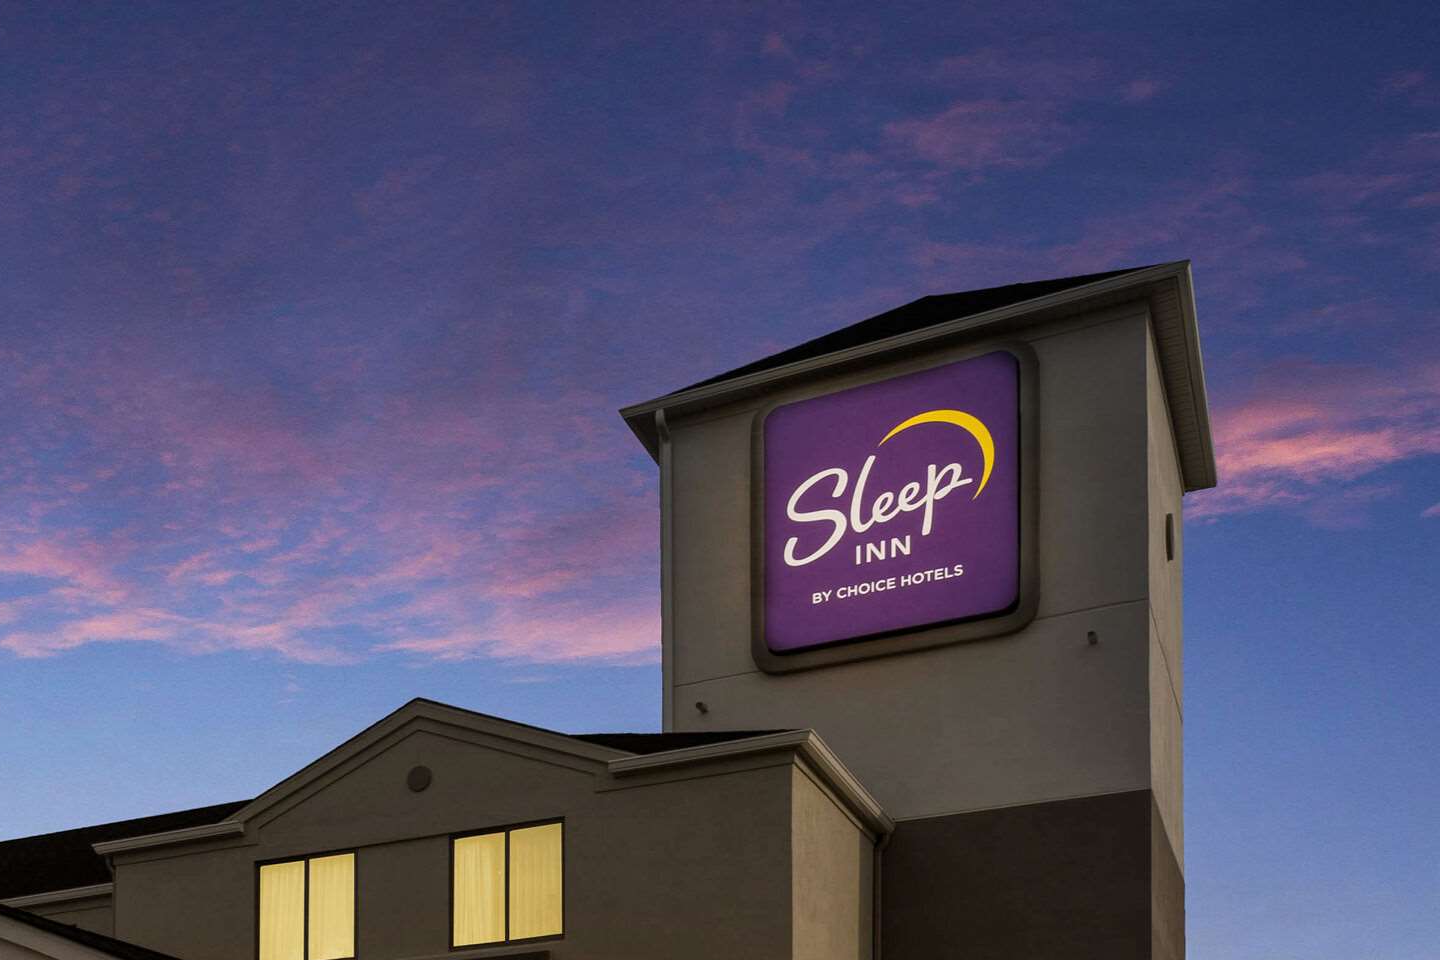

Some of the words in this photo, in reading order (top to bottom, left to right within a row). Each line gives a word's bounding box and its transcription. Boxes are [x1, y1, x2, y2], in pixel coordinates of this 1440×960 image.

[784, 455, 973, 567] Sleep
[855, 535, 911, 565] INN
[812, 590, 832, 604] BY
[836, 578, 896, 599] CHOICE
[900, 564, 964, 587] HOTELS
